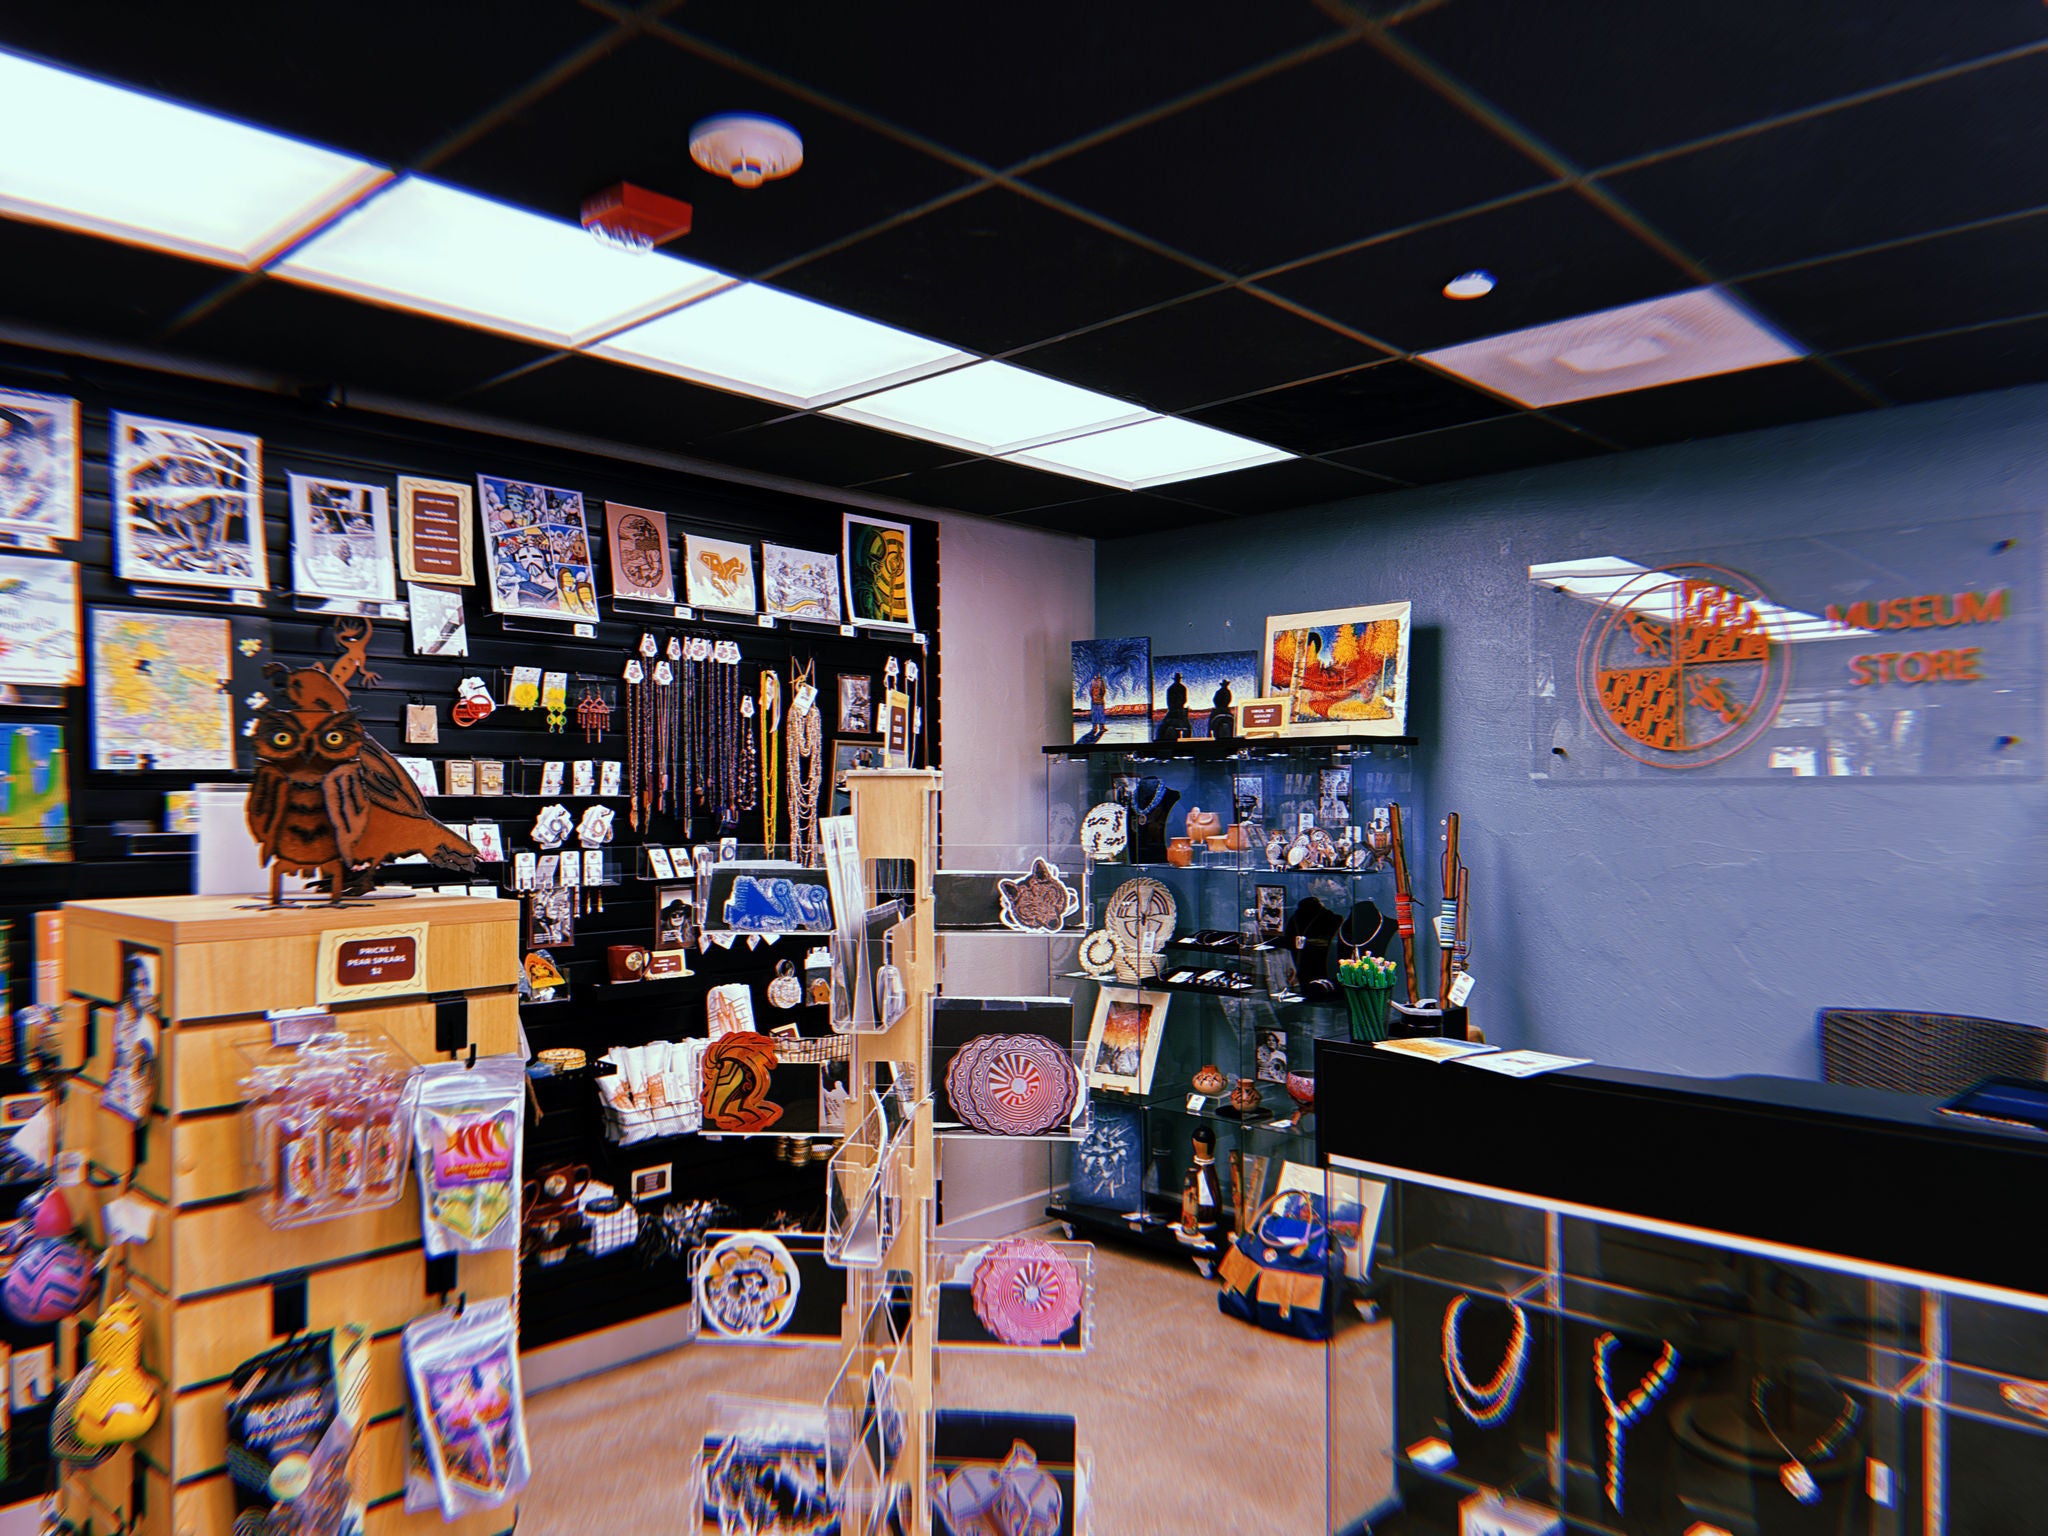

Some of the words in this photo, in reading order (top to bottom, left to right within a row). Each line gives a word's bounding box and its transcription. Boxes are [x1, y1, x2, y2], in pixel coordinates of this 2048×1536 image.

[1825, 589, 2007, 631] MUSEUM
[1848, 647, 1986, 686] STORE
[346, 957, 372, 967] PEAR
[372, 954, 407, 965] SPEARS
[358, 945, 397, 955] PRICKLY
